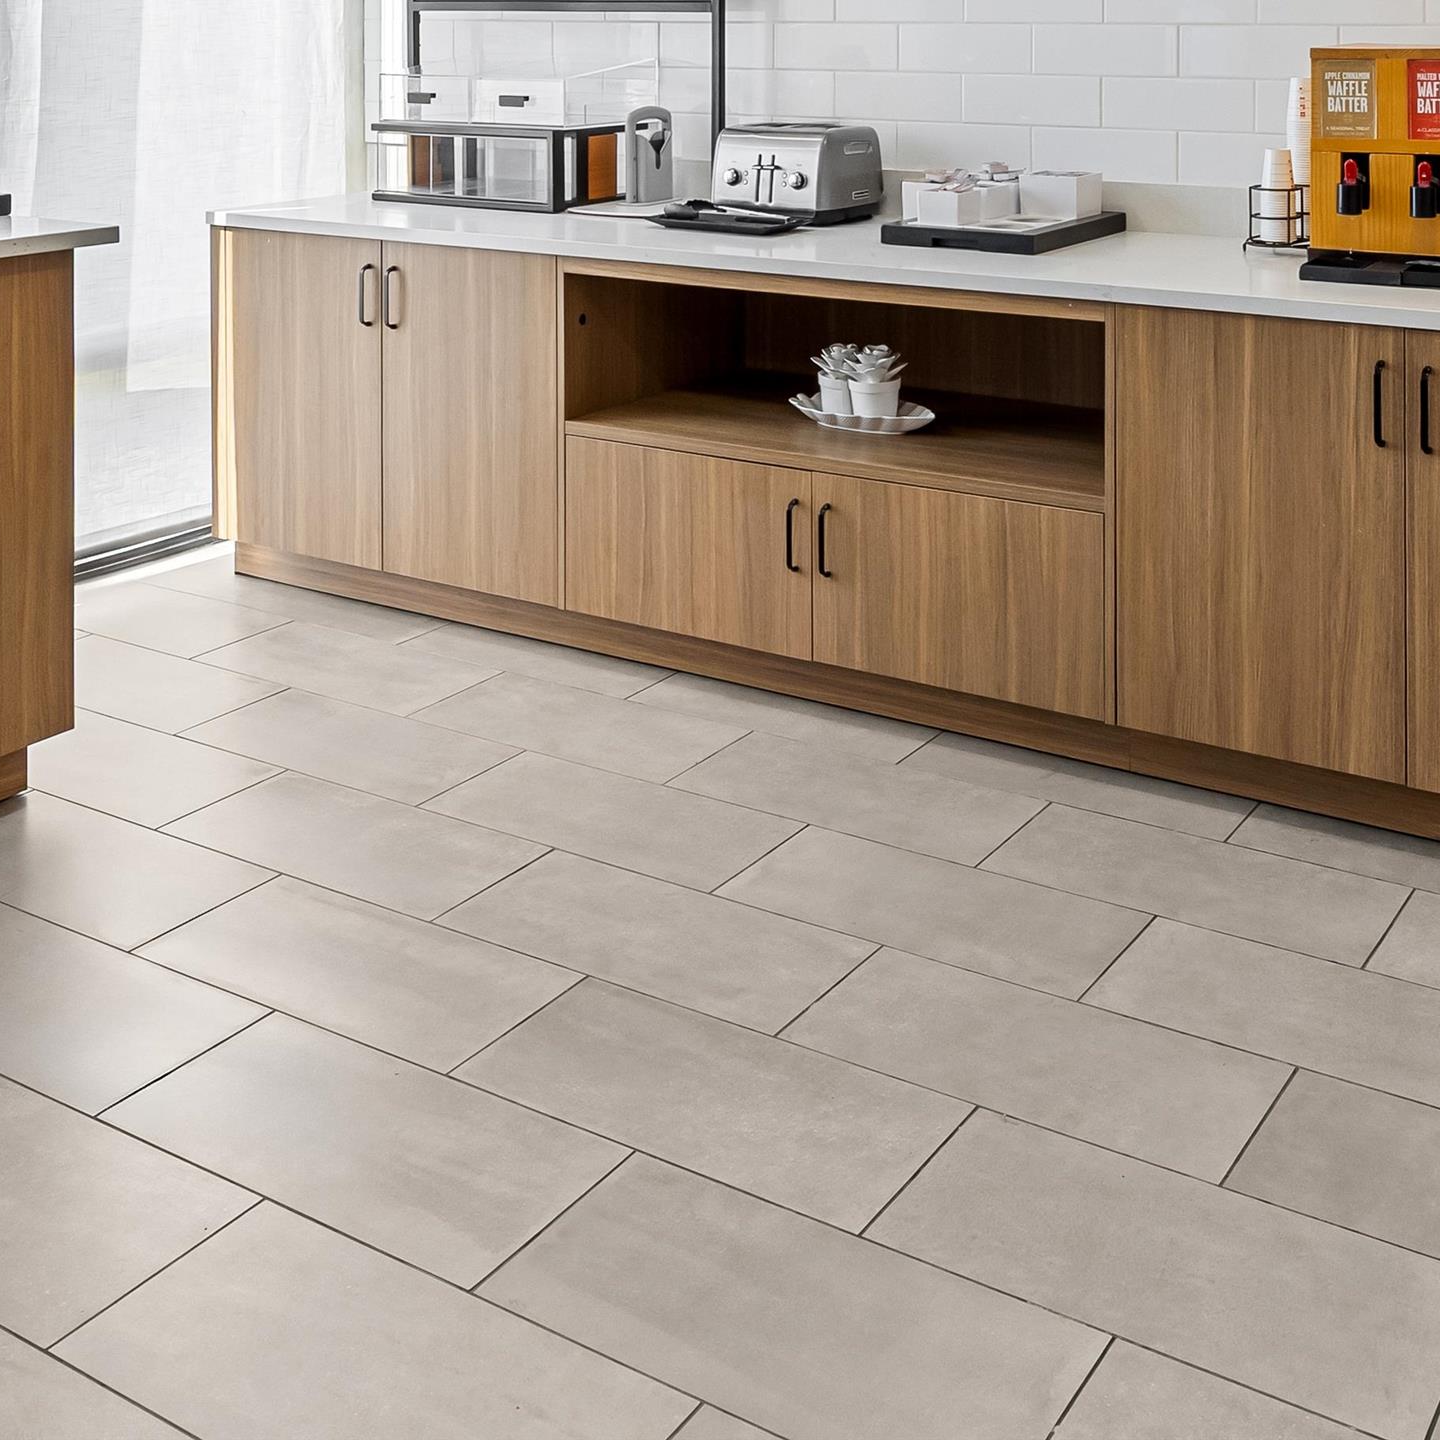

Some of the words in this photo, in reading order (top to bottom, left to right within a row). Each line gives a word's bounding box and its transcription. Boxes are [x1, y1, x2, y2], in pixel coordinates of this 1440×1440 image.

[1324, 71, 1341, 80] APPLE
[1327, 80, 1368, 96] WAFFLE
[1327, 97, 1368, 113] BATTER
